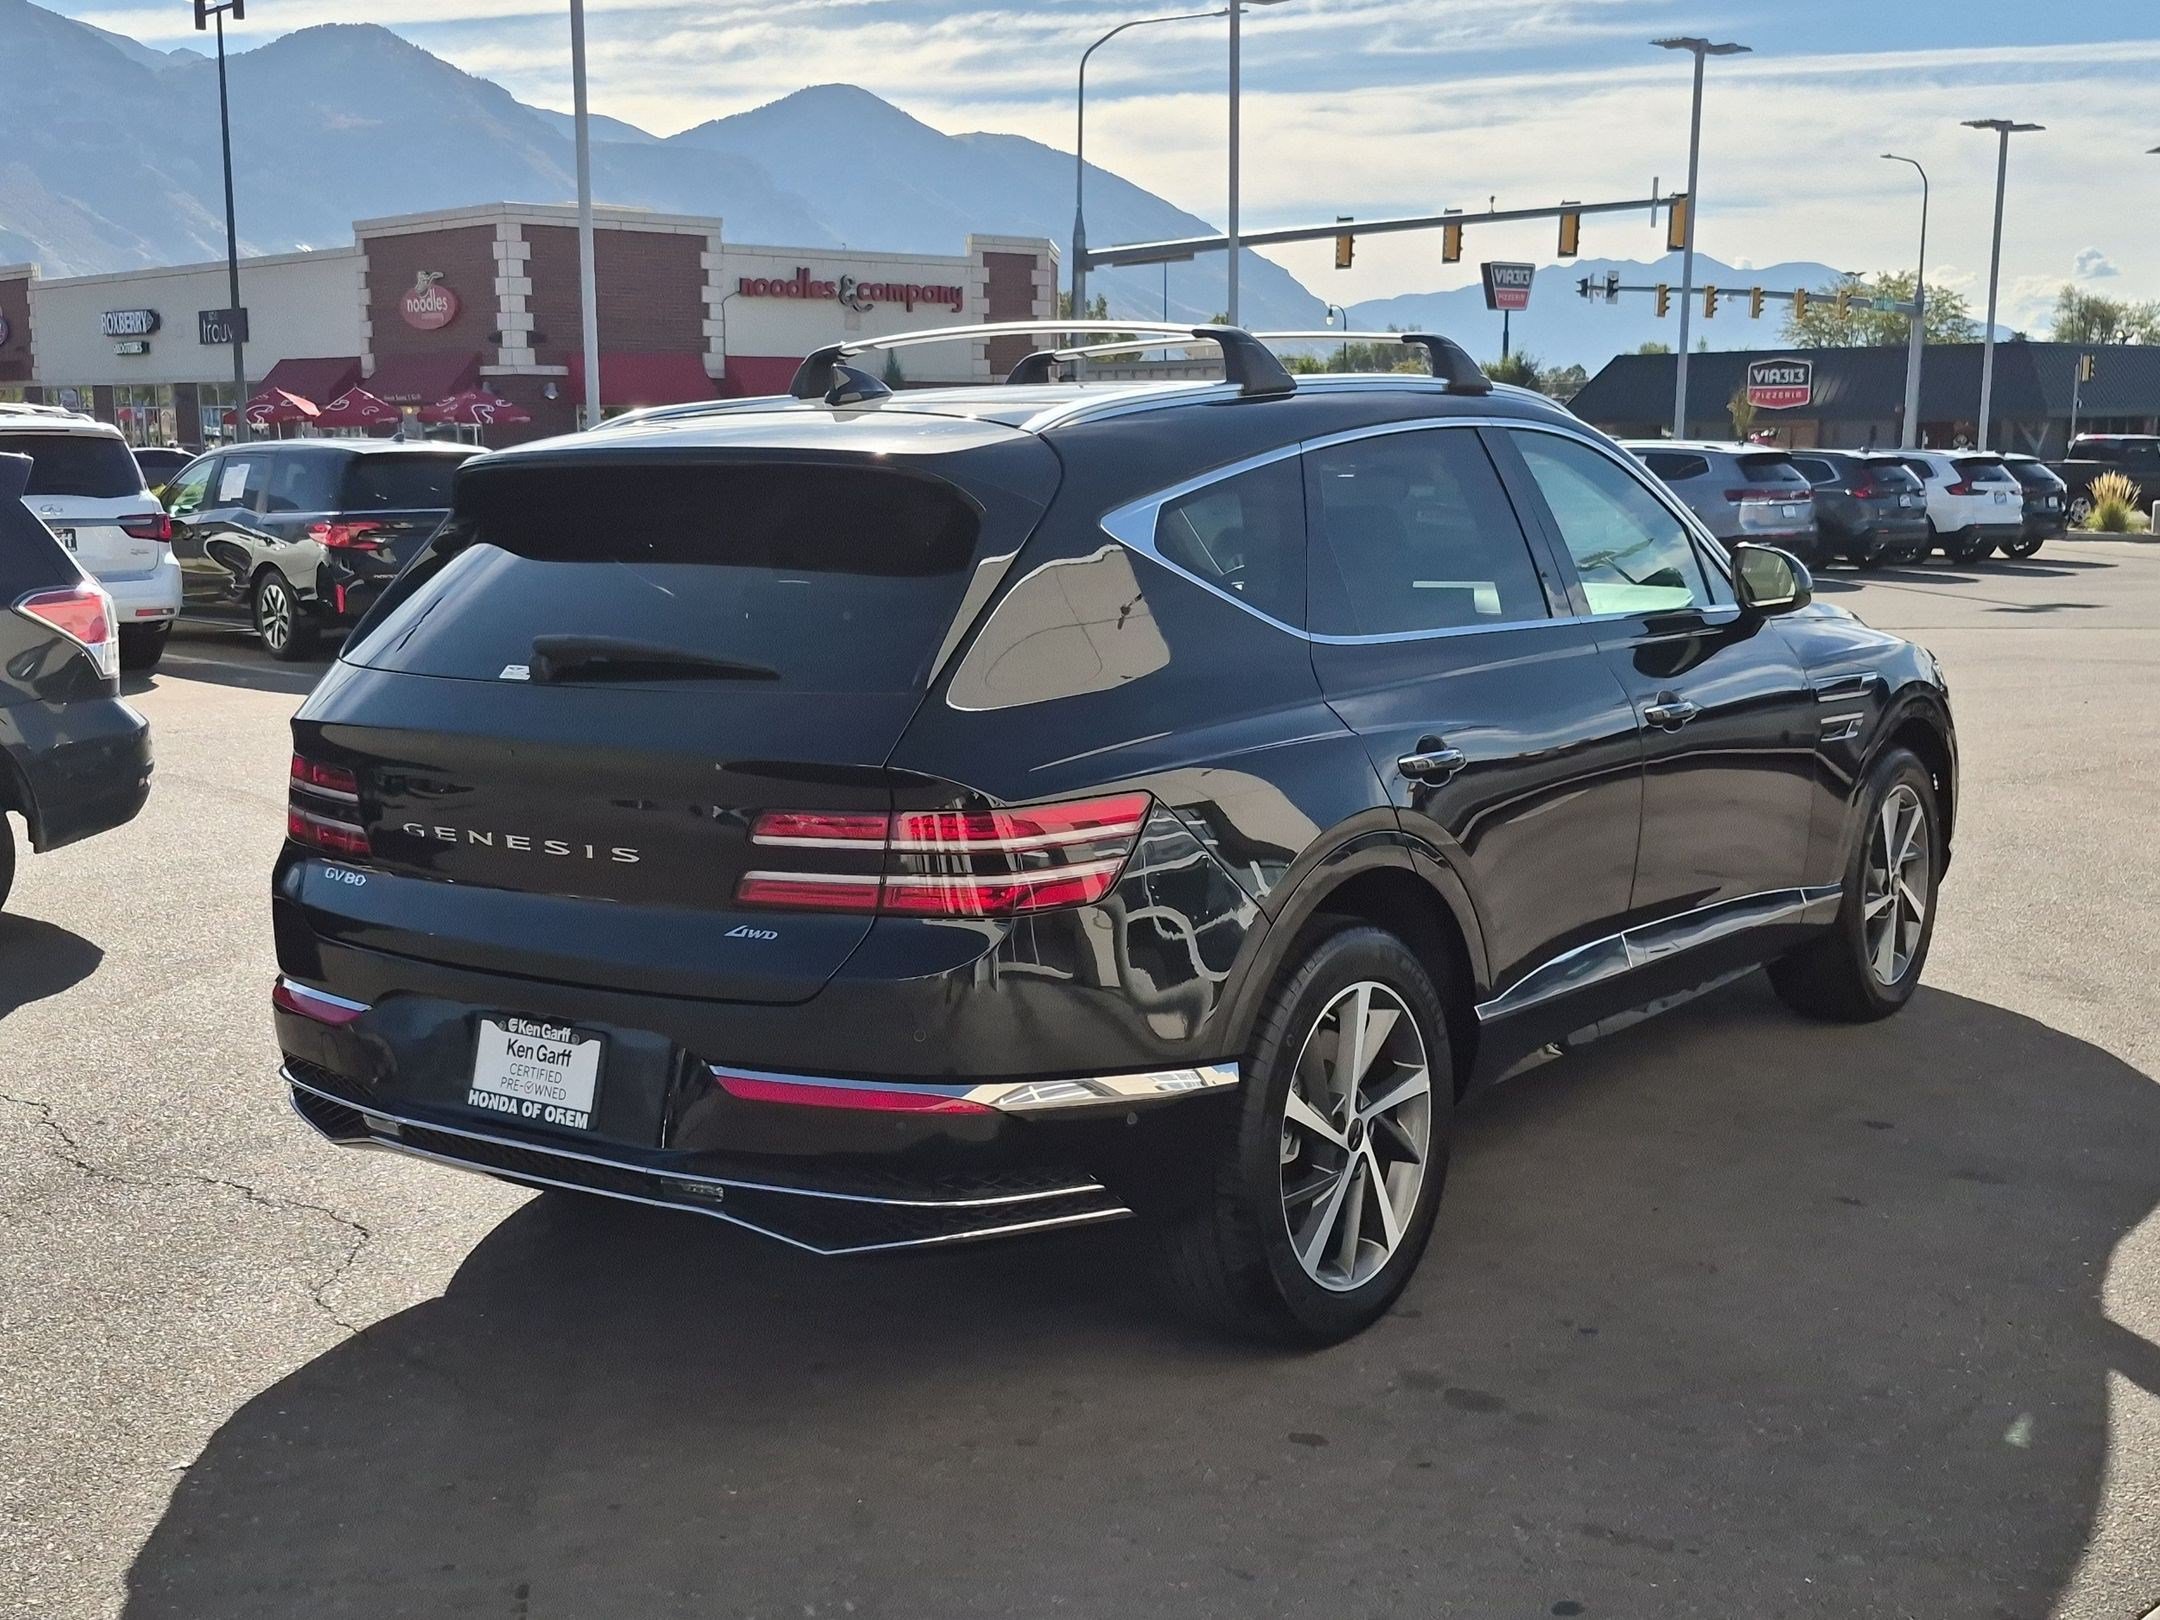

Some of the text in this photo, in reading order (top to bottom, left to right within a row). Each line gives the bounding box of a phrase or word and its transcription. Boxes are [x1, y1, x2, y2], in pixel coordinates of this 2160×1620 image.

[406, 287, 448, 313] noodles
[738, 267, 837, 299] noodles
[856, 282, 963, 312] company
[101, 310, 148, 335] ROXBERRY
[1754, 391, 1803, 400] PIZZERIA
[402, 822, 641, 864] GENESIS
[325, 867, 367, 887] GV80
[723, 925, 778, 940] AWD
[518, 1018, 572, 1043] Ken Garff
[506, 1038, 573, 1067] Ken Garff
[509, 1063, 563, 1085] CERTIFIED
[467, 1089, 590, 1130] HONDA OF OREM
